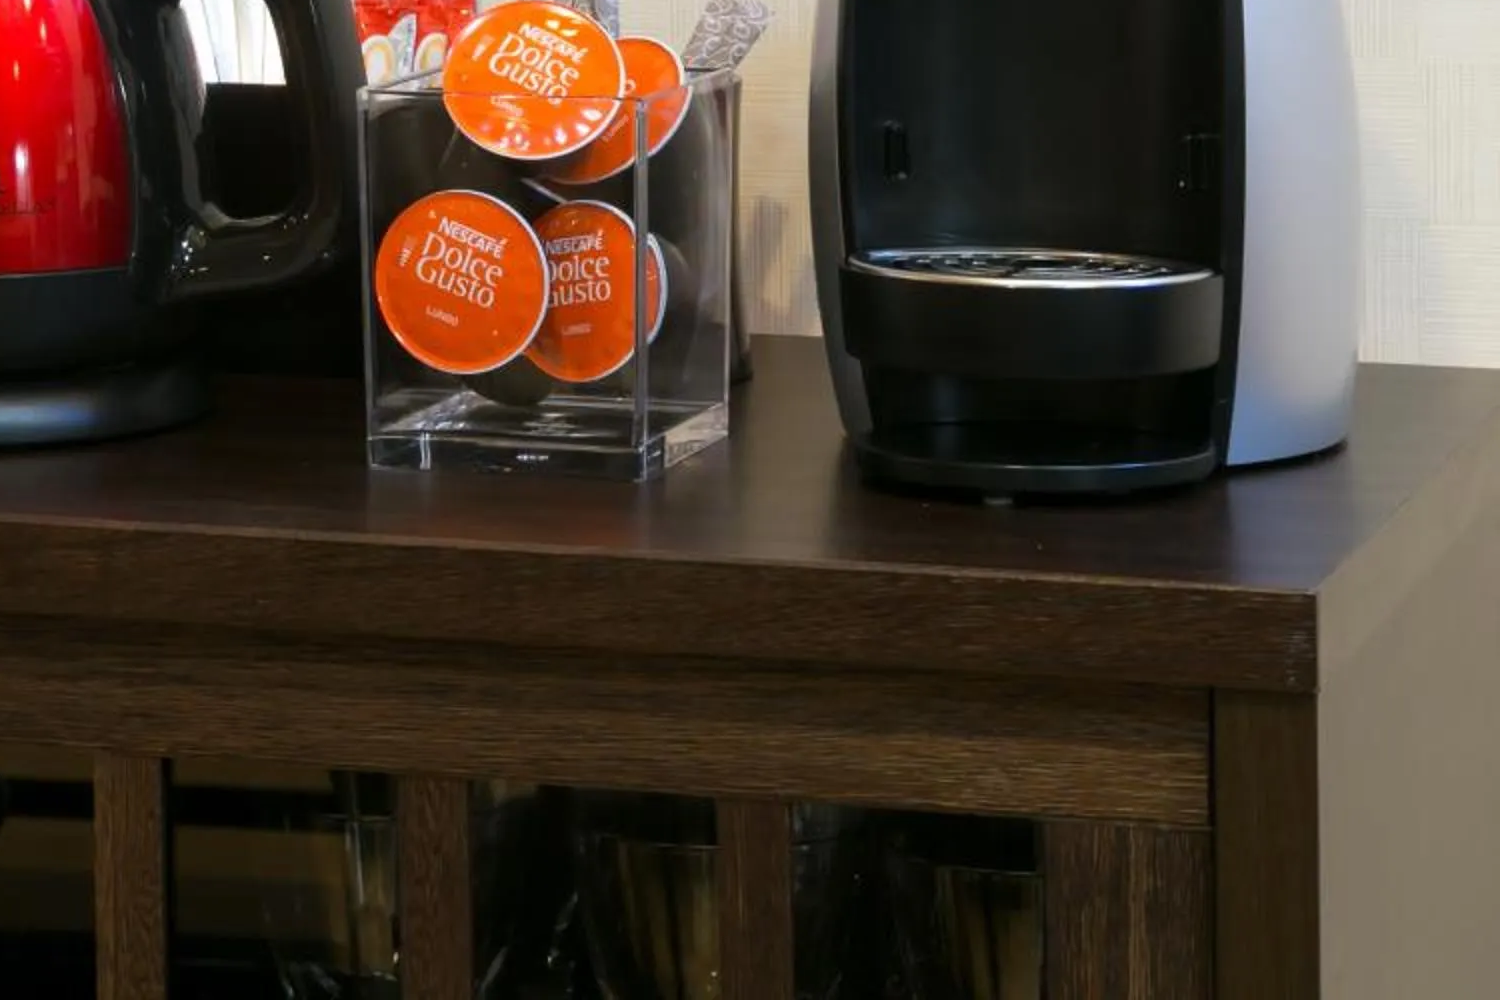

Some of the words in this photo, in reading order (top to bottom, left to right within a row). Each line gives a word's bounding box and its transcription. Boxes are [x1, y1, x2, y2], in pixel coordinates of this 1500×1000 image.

[488, 52, 569, 106] Gusto
[498, 31, 581, 86] Dolce
[422, 231, 504, 288] Dolce
[438, 216, 509, 259] NESCAFÉ
[415, 256, 495, 309] Gusto
